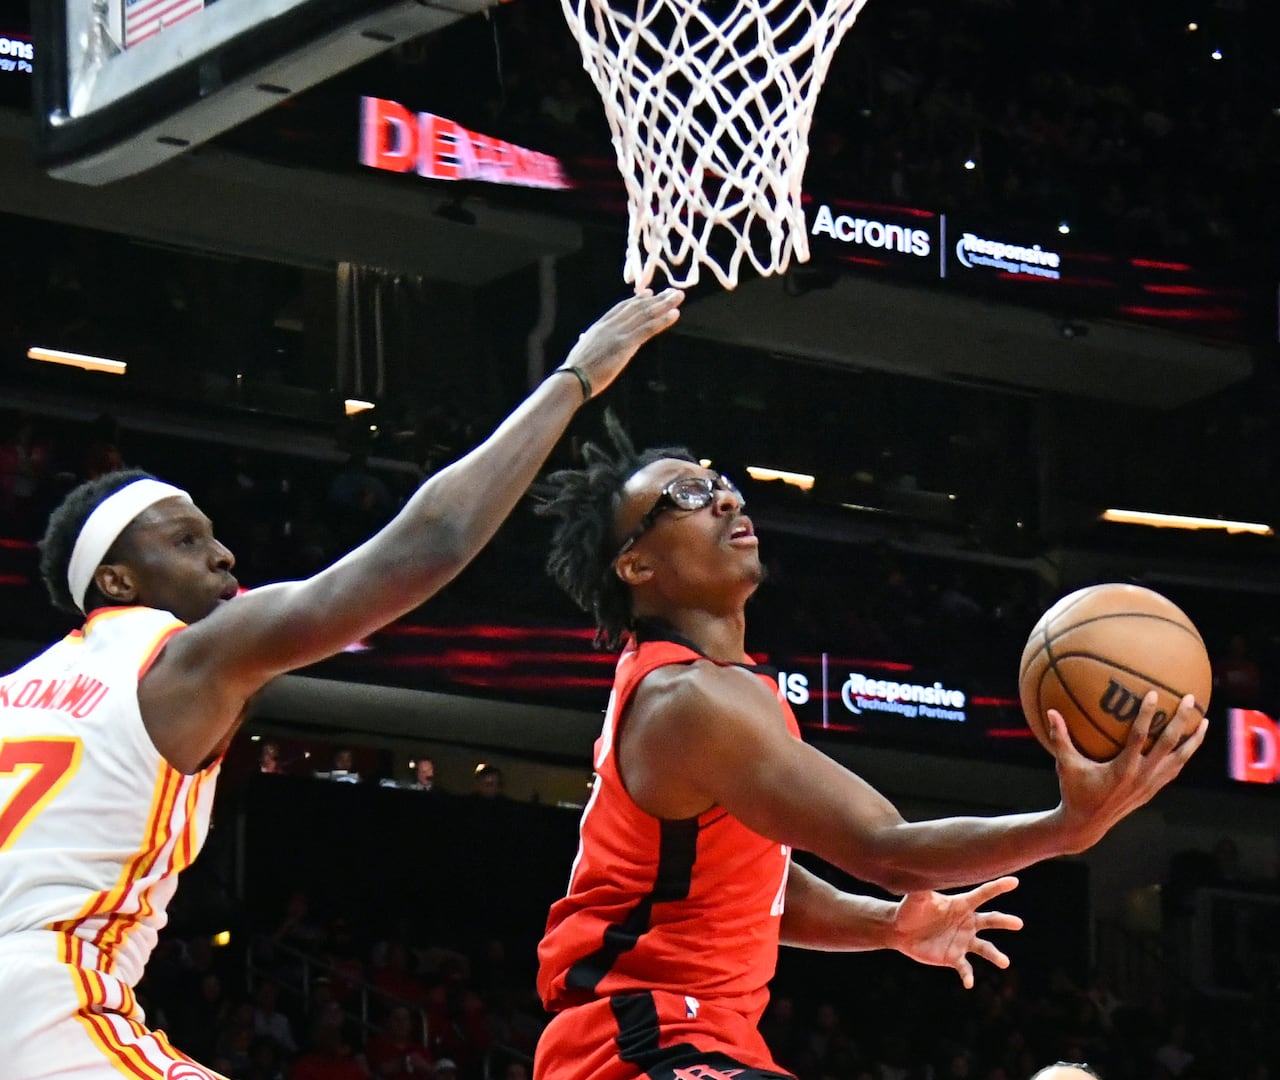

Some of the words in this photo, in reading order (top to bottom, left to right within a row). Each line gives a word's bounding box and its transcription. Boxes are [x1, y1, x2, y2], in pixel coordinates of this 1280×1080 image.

[811, 205, 931, 257] Acronis
[962, 233, 1061, 268] Responsive
[849, 672, 966, 708] Responsive
